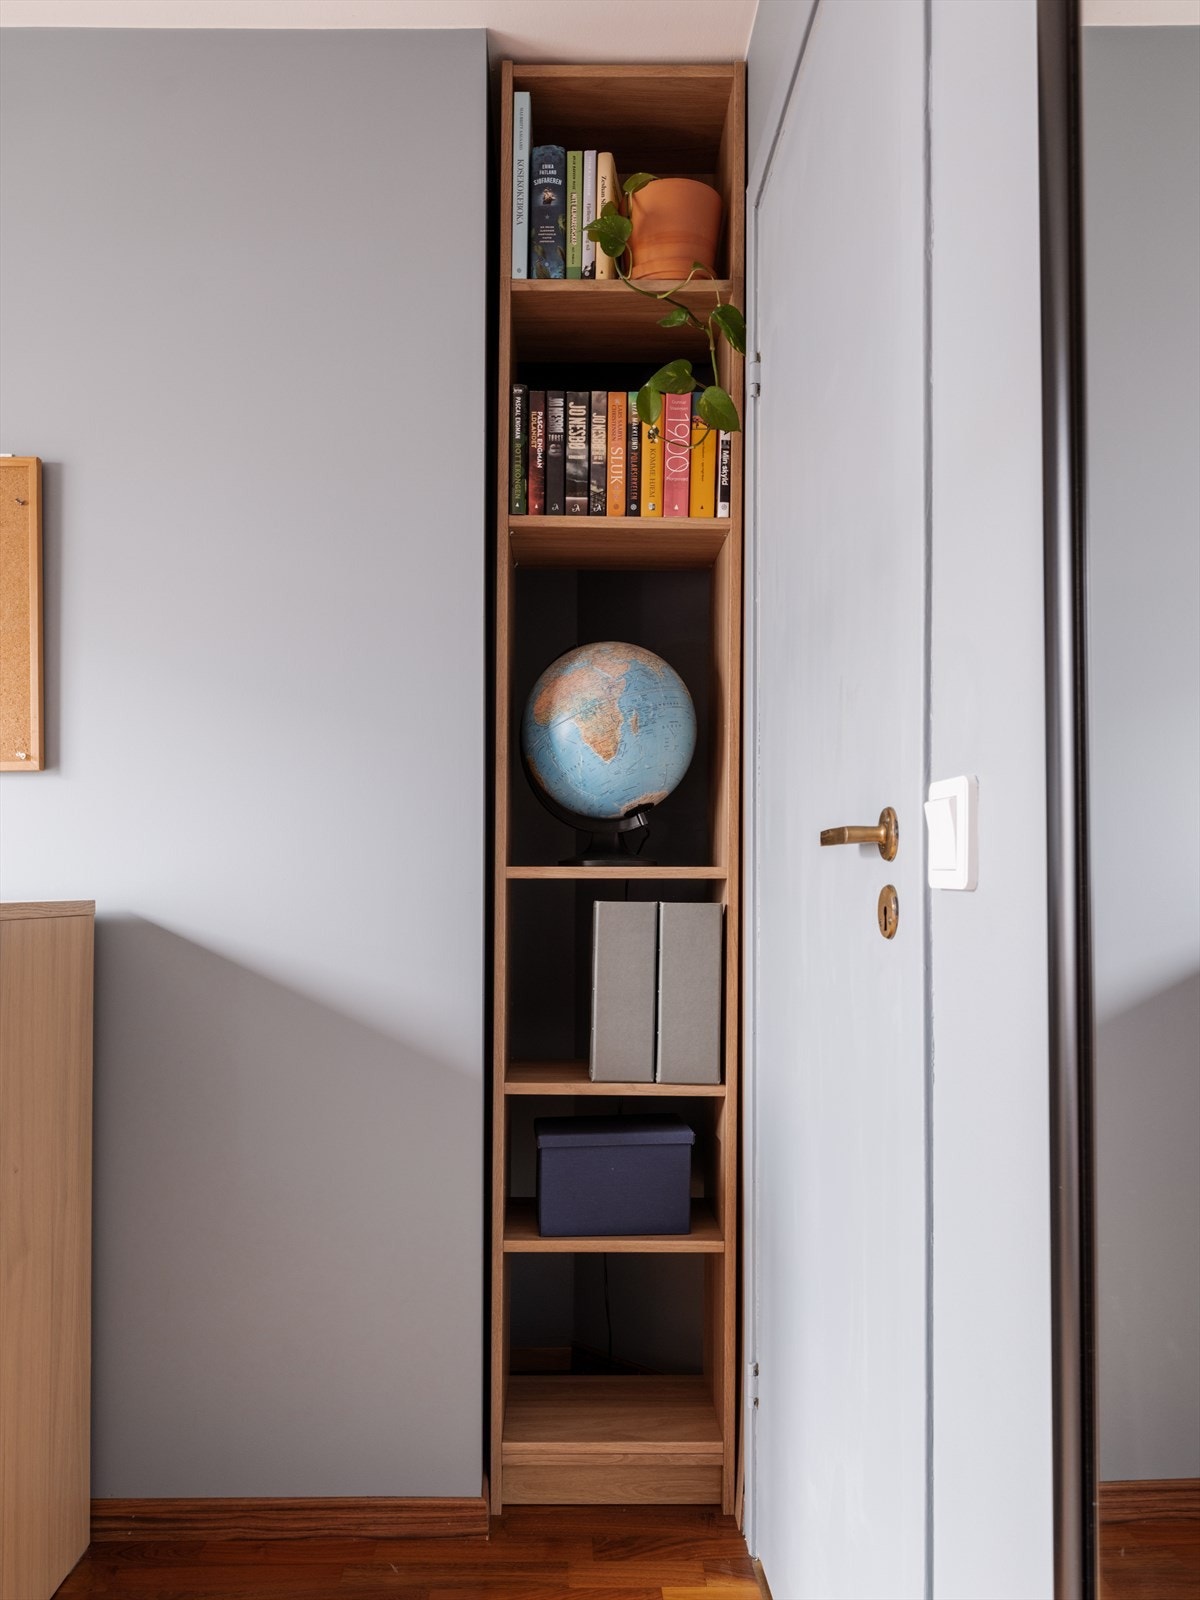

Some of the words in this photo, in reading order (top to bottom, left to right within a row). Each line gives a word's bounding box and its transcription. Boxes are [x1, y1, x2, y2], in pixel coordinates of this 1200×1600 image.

[516, 159, 525, 226] KOSEKOKEBOKA
[548, 397, 564, 406] JO
[568, 401, 587, 416] JO
[548, 407, 564, 433] NESBØ
[592, 412, 606, 424] JO
[567, 417, 587, 450] NESBØ
[592, 424, 606, 448] NESBØ
[666, 413, 690, 473] 1900
[610, 446, 624, 485] SLUK
[649, 448, 657, 476] KOMME
[722, 450, 730, 464] Min
[630, 451, 638, 500] POLARSIRKELEN
[720, 465, 729, 486] skyld
